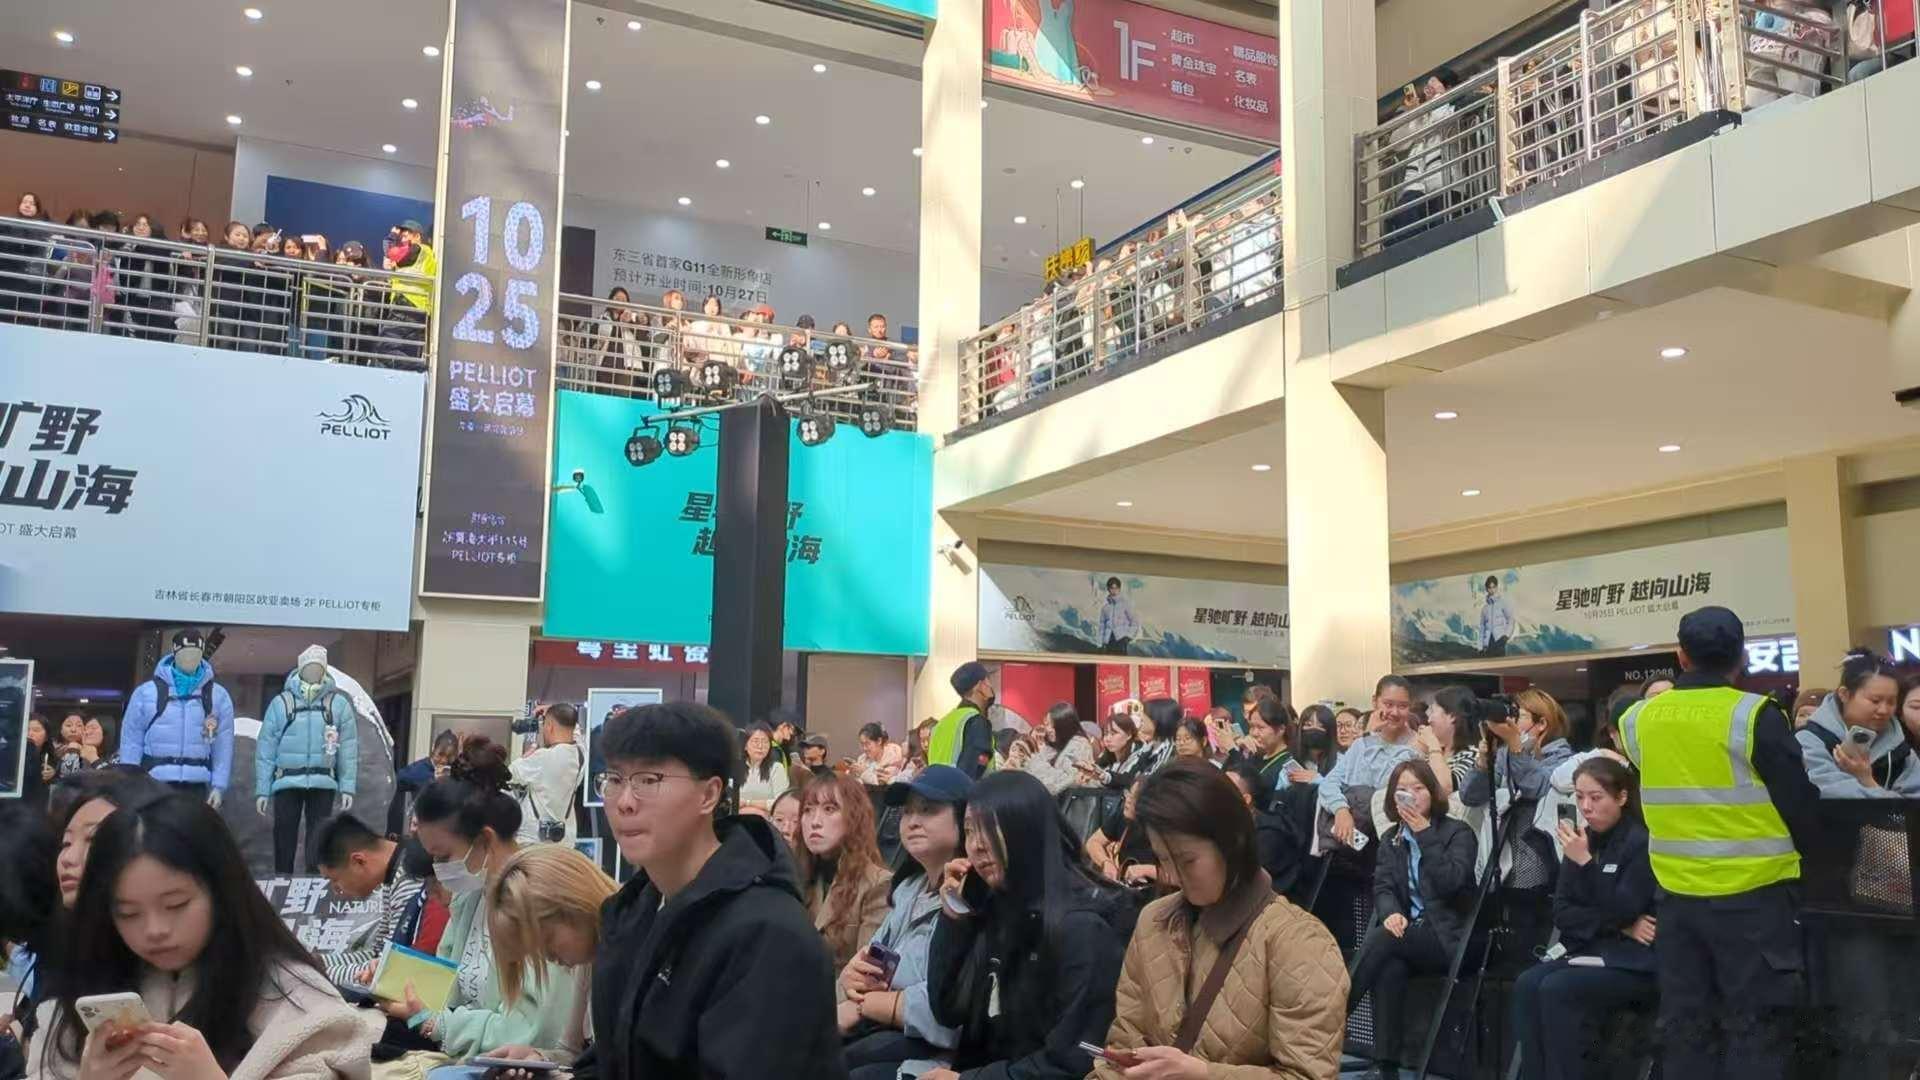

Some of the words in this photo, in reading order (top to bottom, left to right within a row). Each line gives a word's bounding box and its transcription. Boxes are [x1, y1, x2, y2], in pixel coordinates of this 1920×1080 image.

[1170, 29, 1194, 45] 超市
[1113, 19, 1156, 81] 1F
[1171, 53, 1217, 76] 黄金珠宝
[1170, 79, 1194, 97] 箱包
[1235, 69, 1257, 86] 名表
[1233, 94, 1269, 114] 化妆品
[461, 195, 544, 271] 10
[611, 247, 773, 287] 东三省首家G11全新形象店
[452, 271, 539, 349] 25
[449, 359, 537, 389] PELLIOT
[449, 386, 536, 417] 盛大启幕
[320, 423, 391, 440] PELLIOT
[0, 459, 138, 514] 山海
[19, 523, 77, 539] 盛大启幕
[154, 588, 301, 608] 吉林省长春市朝阳区欧亚卖场
[304, 597, 316, 609] 2F
[318, 599, 382, 612] PELLIOT专柜
[1555, 582, 1626, 612] 星驰旷野
[1628, 571, 1712, 602] 越向山海
[1193, 607, 1248, 626] 星驰旷野
